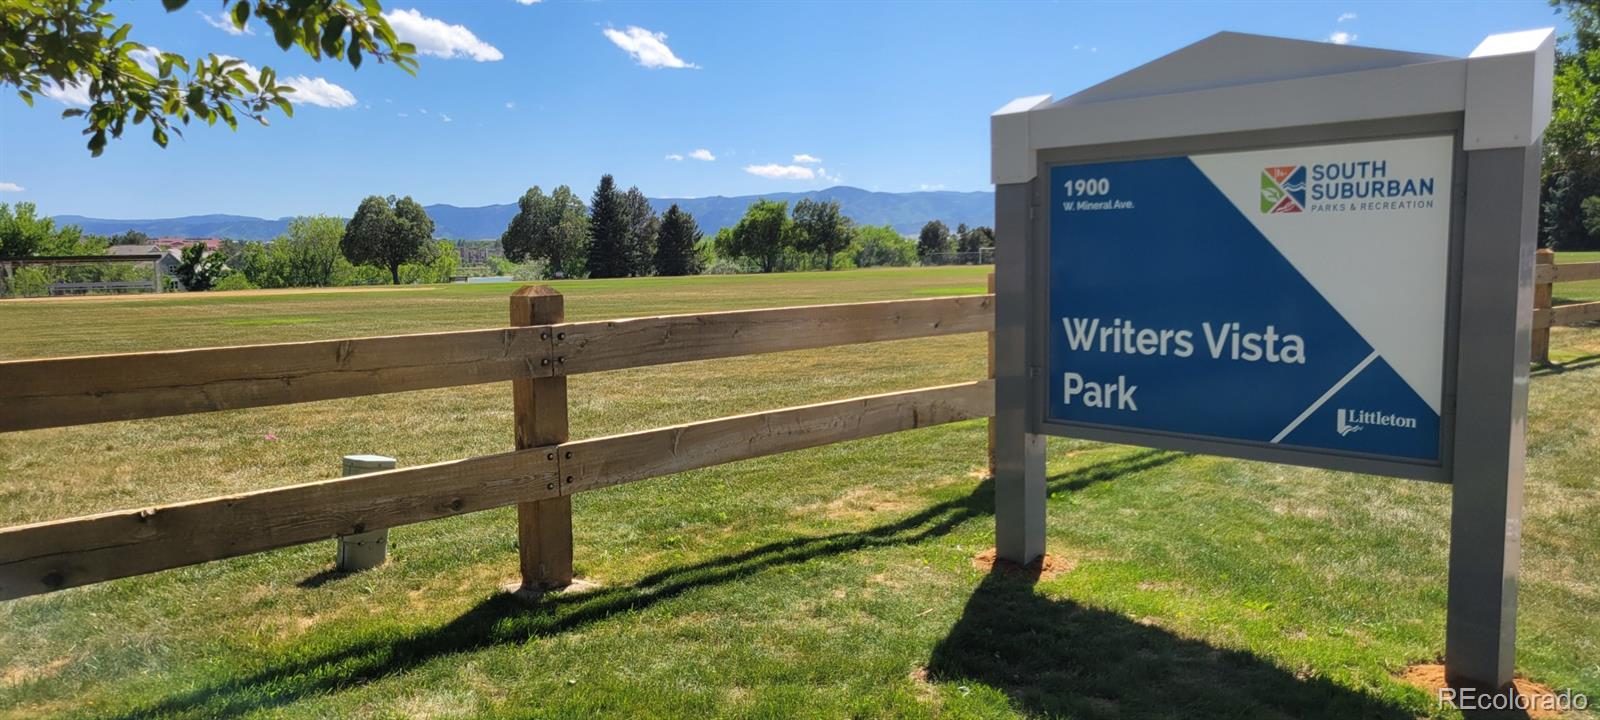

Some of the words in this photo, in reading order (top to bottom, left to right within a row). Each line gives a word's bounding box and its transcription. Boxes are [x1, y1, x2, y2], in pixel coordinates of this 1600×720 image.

[1311, 160, 1386, 181] SOUTH
[1064, 178, 1110, 197] 1900
[1311, 177, 1434, 200] SUBURBAN
[1063, 202, 1075, 211] W.
[1076, 200, 1112, 211] Mineral
[1113, 199, 1135, 209] Ave.
[1311, 203, 1345, 212] PARKS
[1350, 202, 1356, 211] &
[1360, 200, 1434, 211] RECREATION
[1062, 317, 1194, 357] Writers
[1202, 322, 1306, 364] Vista
[1063, 372, 1138, 411] Park
[1349, 409, 1417, 428] Littleton
